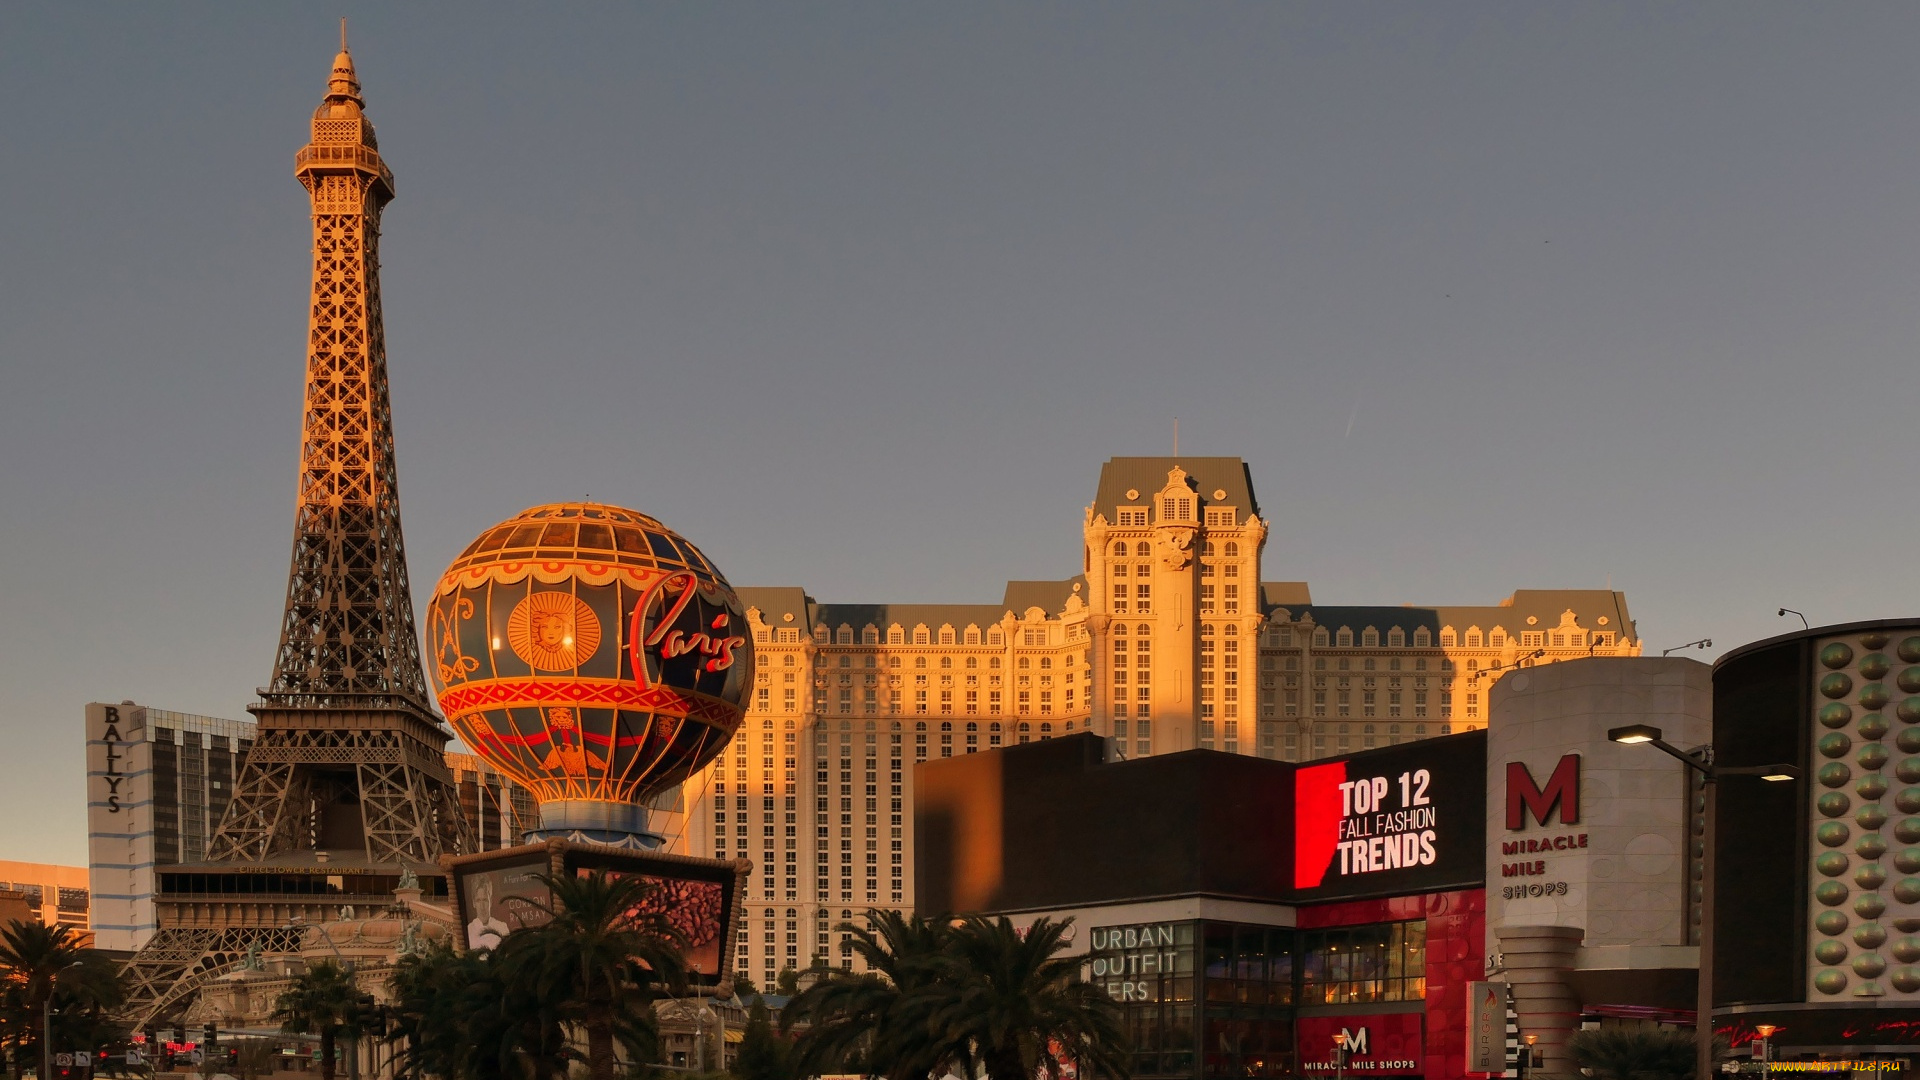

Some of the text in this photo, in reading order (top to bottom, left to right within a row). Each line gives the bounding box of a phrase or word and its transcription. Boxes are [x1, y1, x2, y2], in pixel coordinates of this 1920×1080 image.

[630, 569, 745, 690] Paris
[103, 706, 123, 813] BALLYS
[1339, 769, 1430, 817] TOP 12
[1506, 754, 1581, 830] M
[1339, 807, 1435, 839] FALL FASHION
[1337, 830, 1436, 875] TRENDS
[1502, 833, 1588, 855] MIRACLE
[274, 866, 305, 874] TOWER
[309, 866, 365, 875] RESTAURANT
[1502, 861, 1545, 877] MILE
[1503, 882, 1567, 899] SHOPS
[1093, 925, 1174, 950] URBAN
[1093, 952, 1178, 976] OUTFIT
[1097, 981, 1149, 1000] ERS
[1342, 1027, 1367, 1054] M
[1481, 1012, 1491, 1067] BURGR
[1352, 1061, 1375, 1070] MILE
[1379, 1060, 1415, 1069] SHOPS
